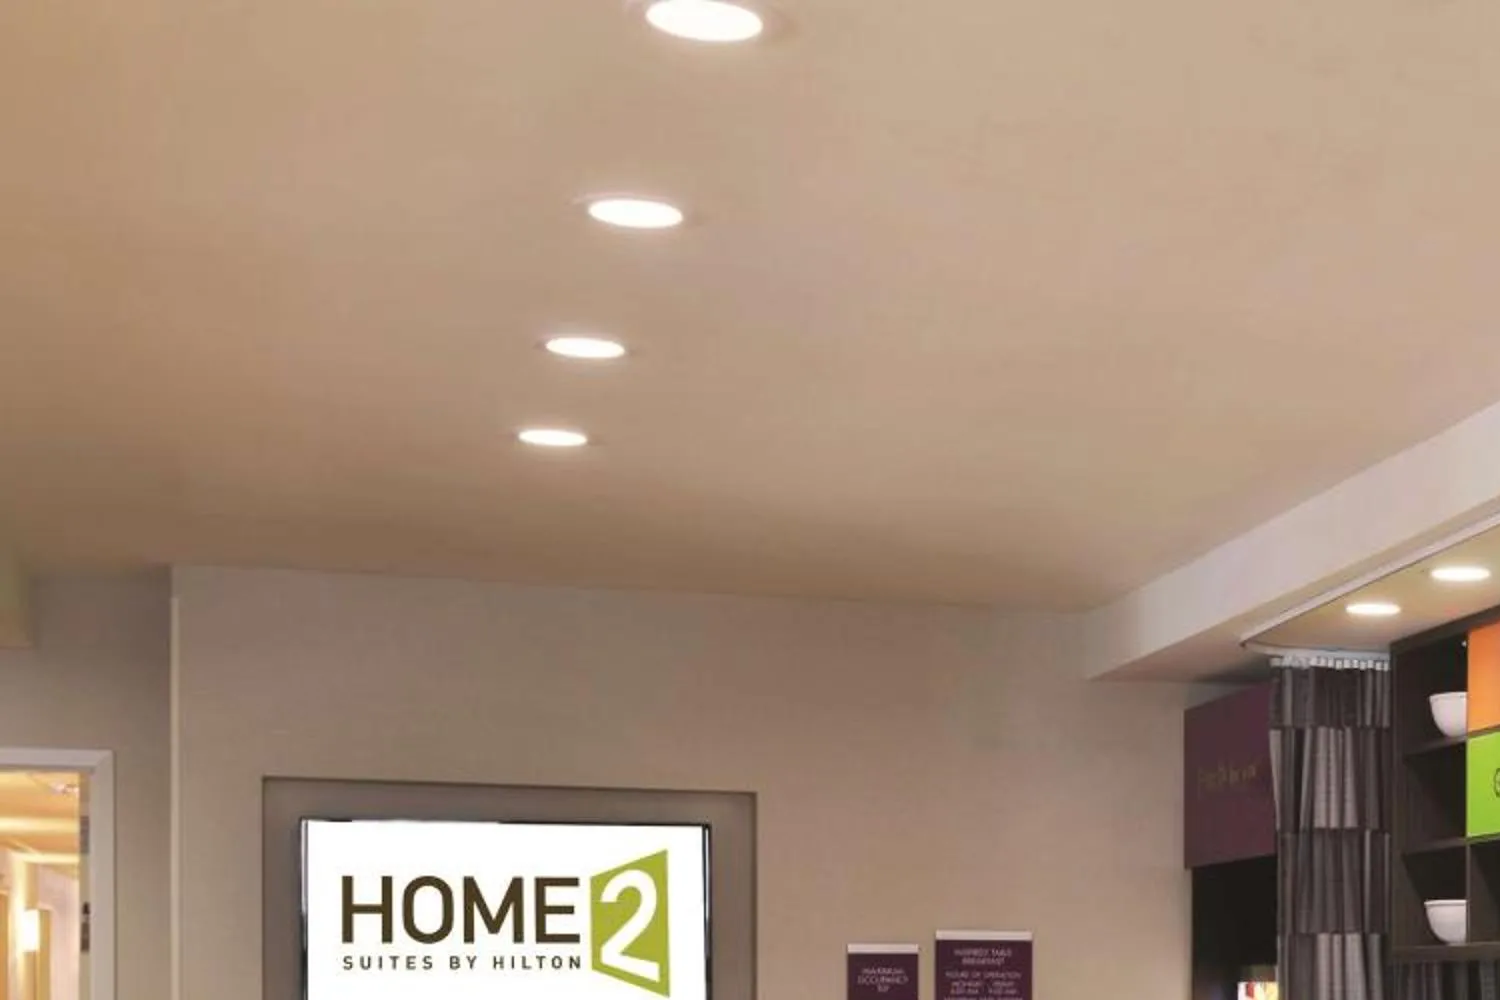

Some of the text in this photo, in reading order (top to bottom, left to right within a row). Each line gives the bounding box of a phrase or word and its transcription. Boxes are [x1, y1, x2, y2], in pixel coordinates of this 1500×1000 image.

[341, 875, 580, 944] HOME
[342, 955, 582, 970] SUITES BY HILTON
